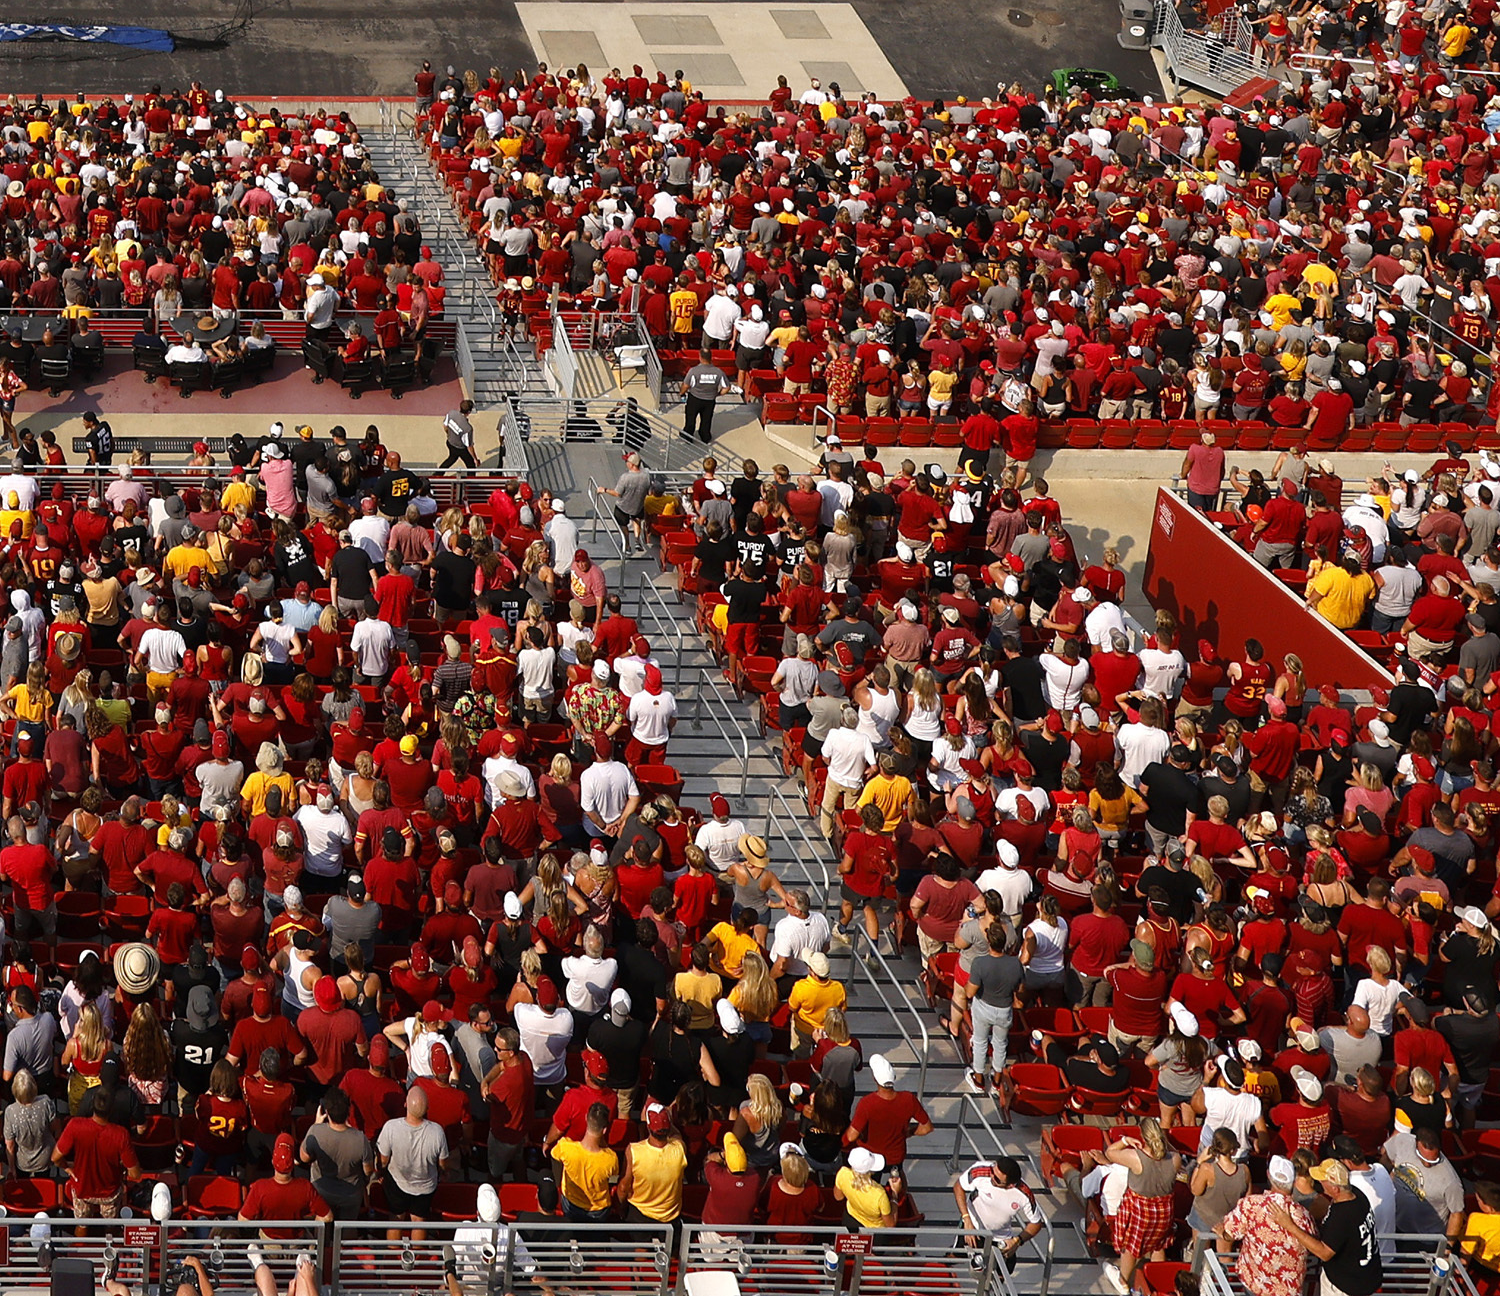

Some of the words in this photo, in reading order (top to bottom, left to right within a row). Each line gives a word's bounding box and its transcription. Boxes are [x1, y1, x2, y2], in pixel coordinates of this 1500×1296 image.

[196, 92, 203, 104] 5
[675, 298, 697, 306] PURDY
[675, 305, 694, 319] 15
[1171, 392, 1181, 403] 18
[738, 540, 765, 552] PURDY
[31, 558, 55, 579] 19
[933, 561, 951, 578] 21
[500, 609, 519, 627] 18
[1242, 685, 1266, 699] 32
[185, 1045, 213, 1065] 21
[208, 1115, 235, 1137] 21
